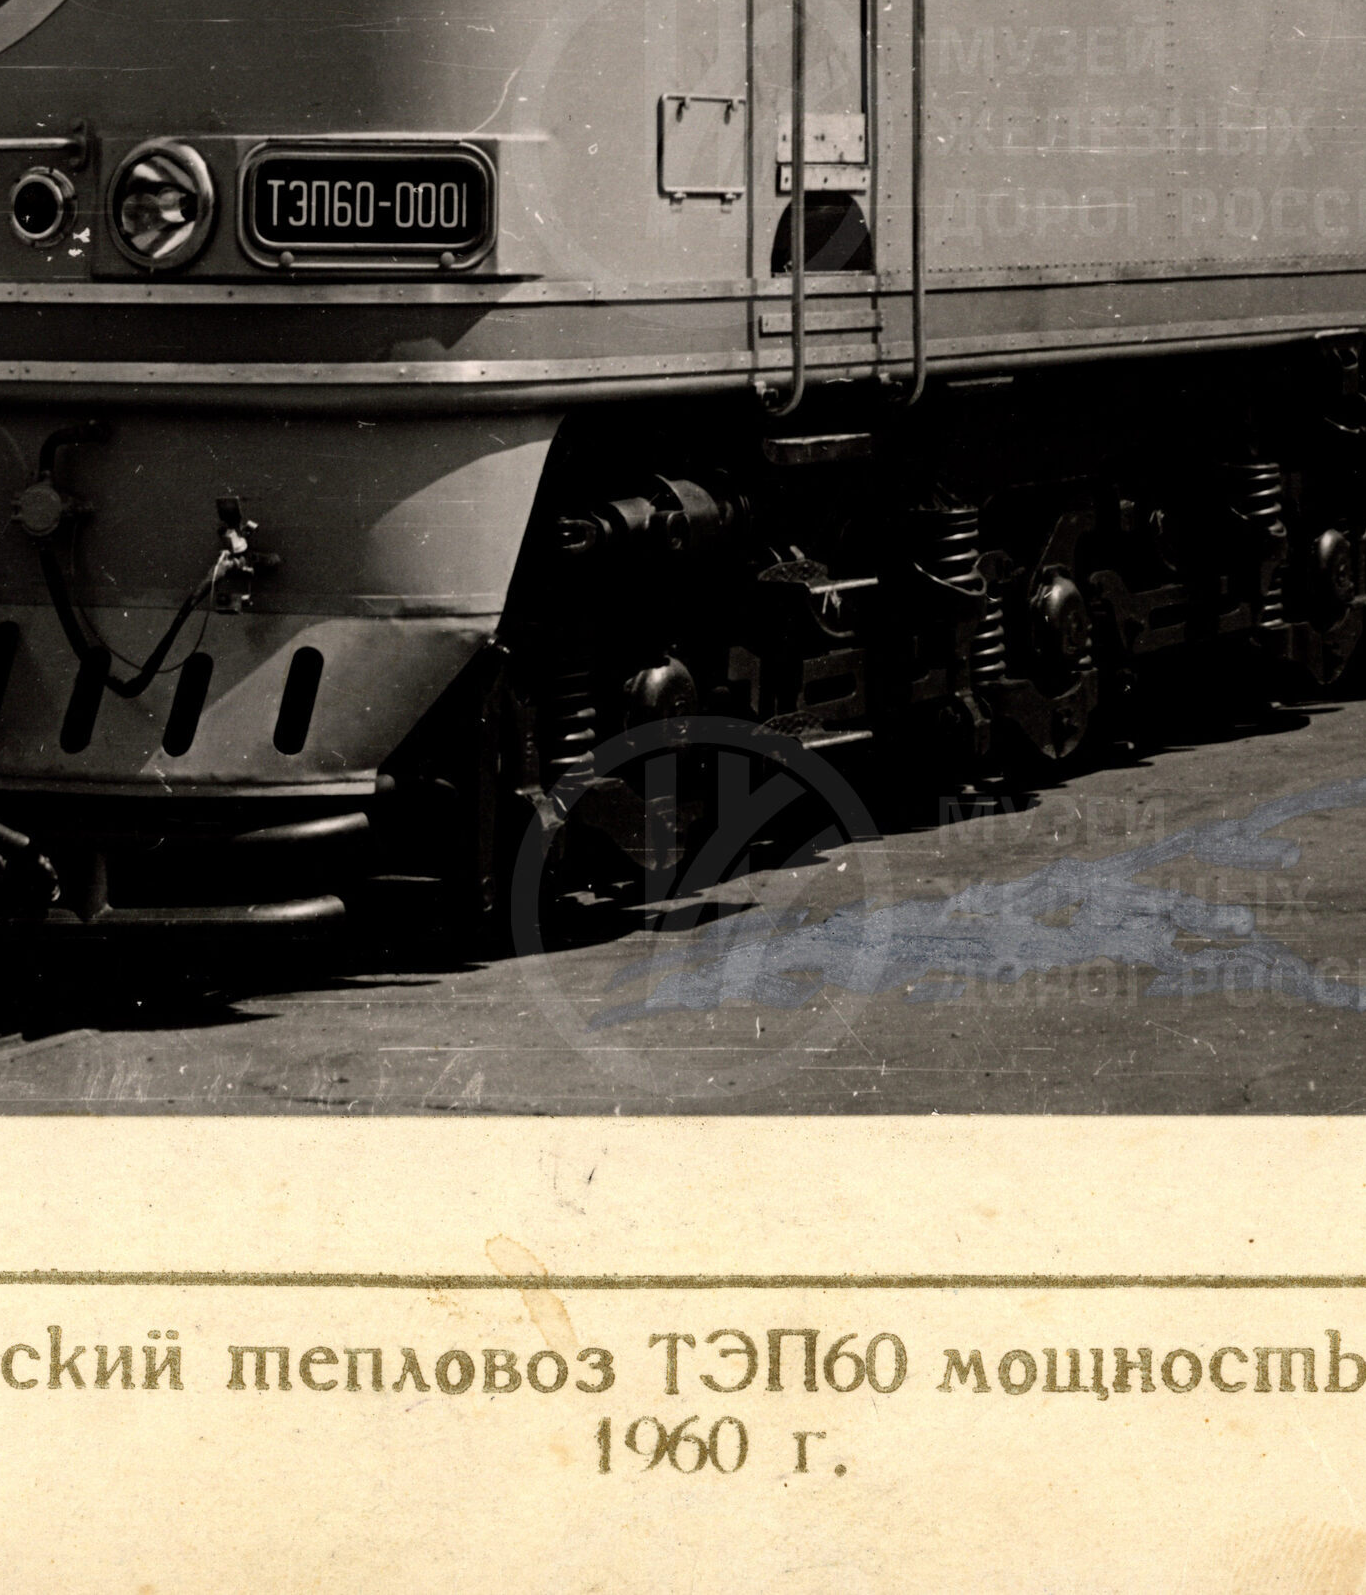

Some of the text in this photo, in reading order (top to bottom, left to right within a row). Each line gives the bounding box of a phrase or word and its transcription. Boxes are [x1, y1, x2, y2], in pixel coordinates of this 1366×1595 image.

[266, 179, 468, 229] ТЭП60-0001
[227, 1346, 617, 1394] тепловоз
[649, 1329, 909, 1396] ТЭП60
[597, 1416, 848, 1477] 1960 г.
